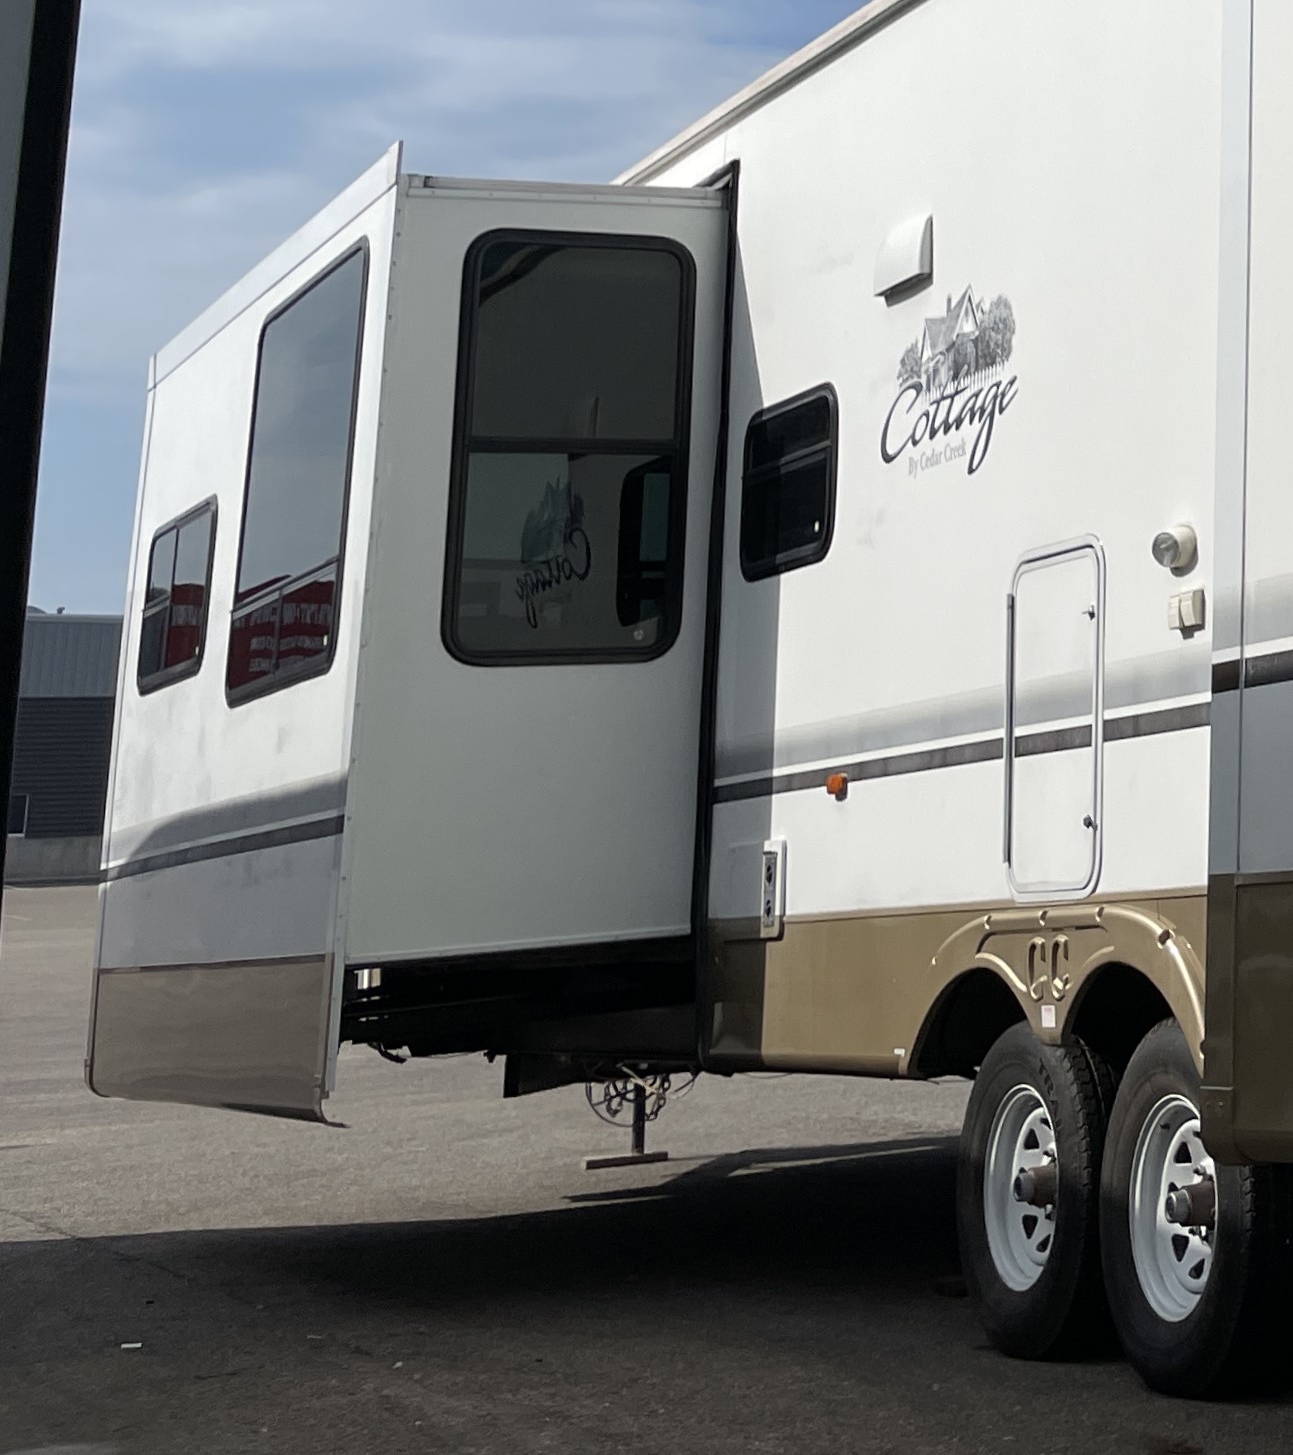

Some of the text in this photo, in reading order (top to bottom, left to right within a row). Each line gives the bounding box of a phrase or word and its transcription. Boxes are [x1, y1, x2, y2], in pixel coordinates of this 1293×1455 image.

[881, 364, 1019, 475] Cottage
[908, 436, 967, 479] By Cedar Creek
